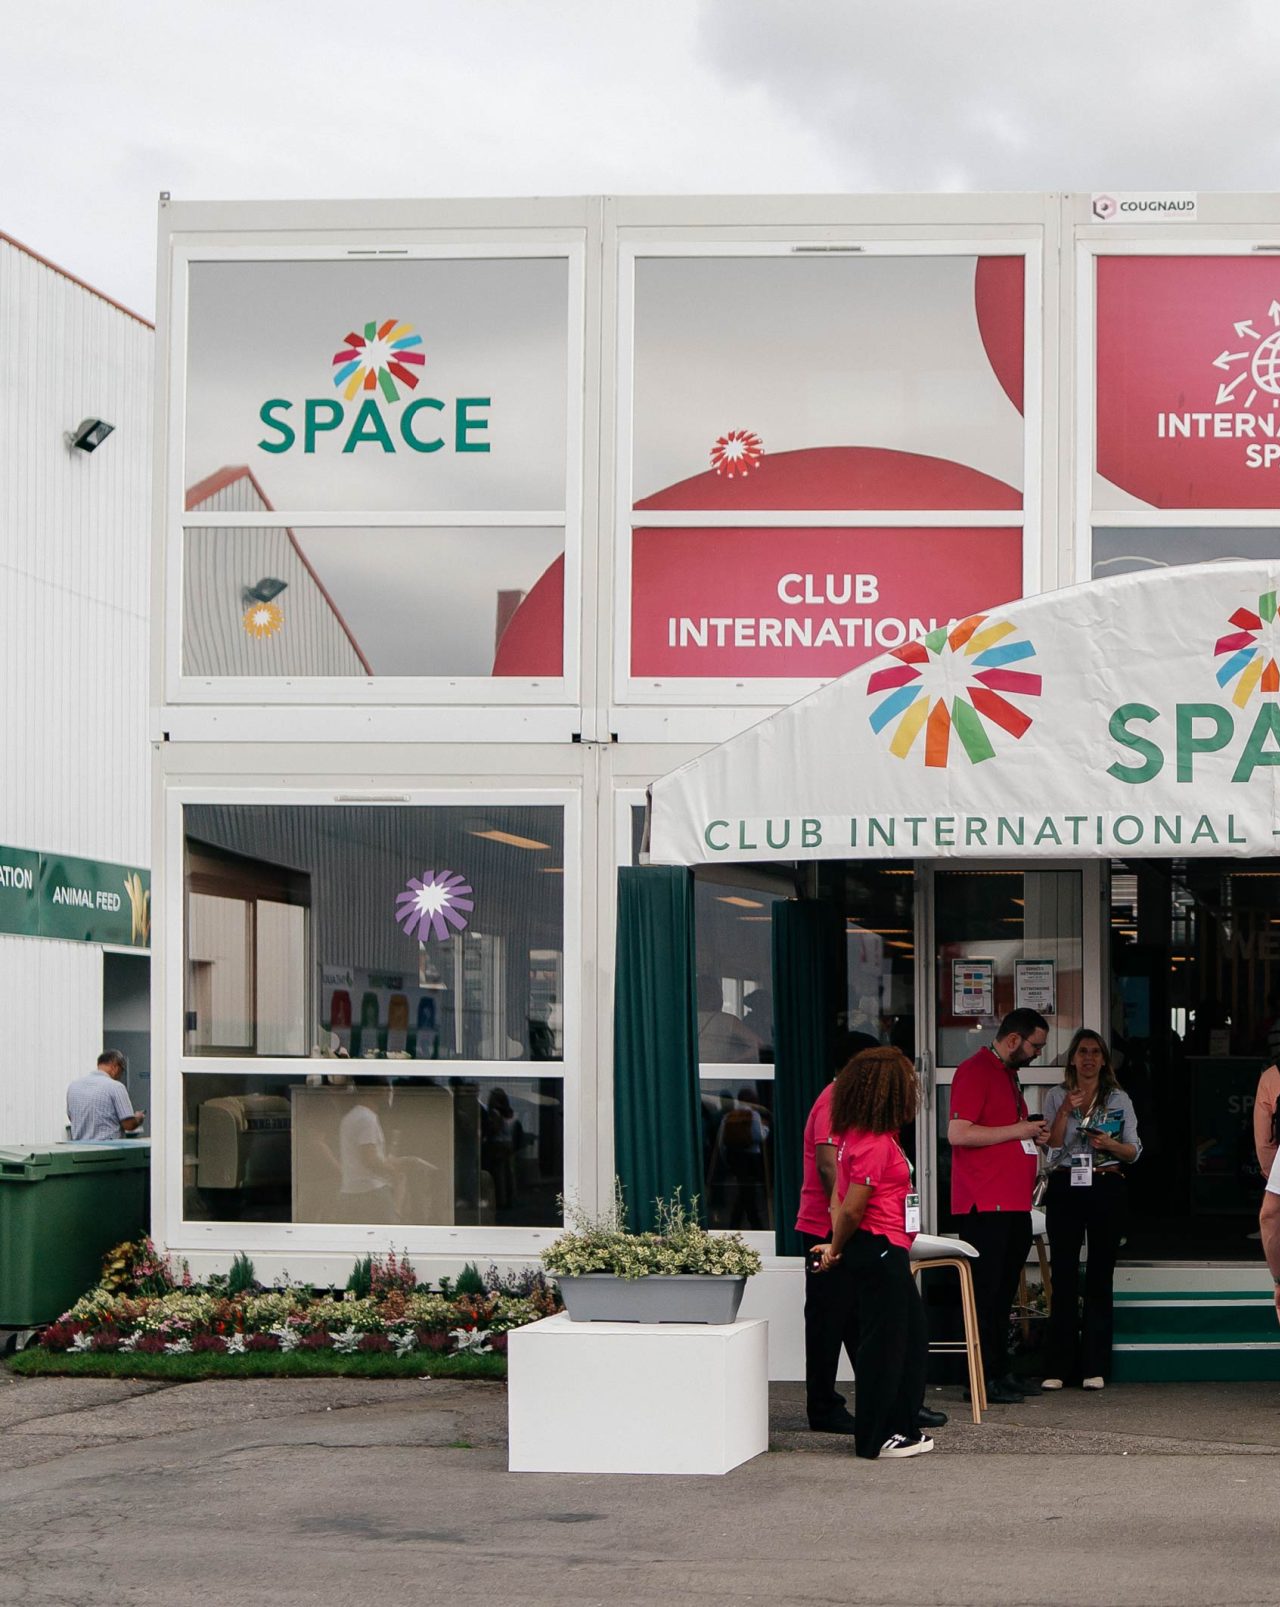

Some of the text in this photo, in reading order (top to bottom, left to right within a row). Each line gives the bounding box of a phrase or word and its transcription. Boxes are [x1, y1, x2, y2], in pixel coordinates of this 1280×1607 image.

[1120, 200, 1195, 212] COUGNAUD
[258, 397, 491, 454] SPACE
[776, 573, 879, 605] CLUB
[667, 617, 957, 648] INTERNATION
[705, 818, 822, 851] CLUB
[850, 814, 1247, 847] INTERNATIONAL
[52, 885, 121, 912] ANIMAL FEED
